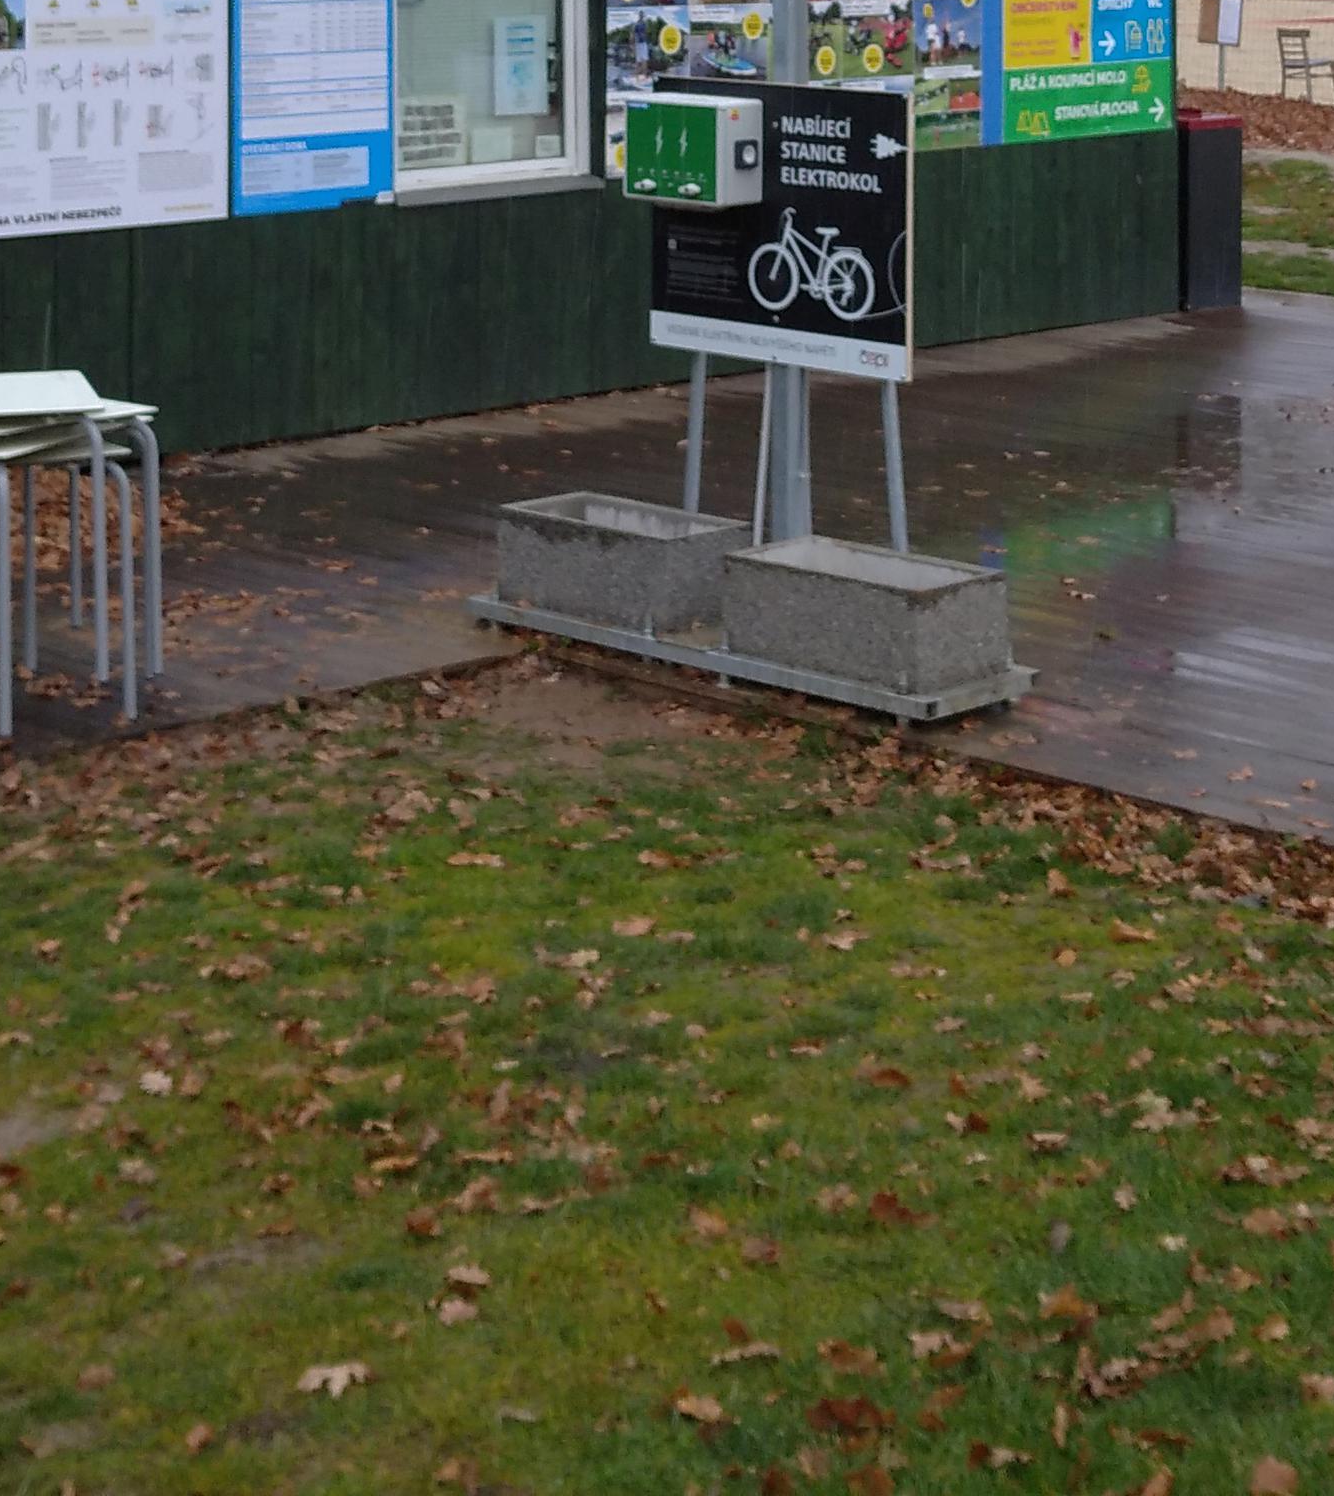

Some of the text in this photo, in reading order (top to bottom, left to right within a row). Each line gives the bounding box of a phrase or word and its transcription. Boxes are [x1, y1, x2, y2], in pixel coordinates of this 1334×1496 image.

[1009, 70, 1127, 91] PLÁŽ A KOUPACÍ MOLO
[781, 115, 851, 138] NABÍJECÍ
[781, 144, 847, 165] STANICE
[781, 167, 883, 194] ELEKTROKOL
